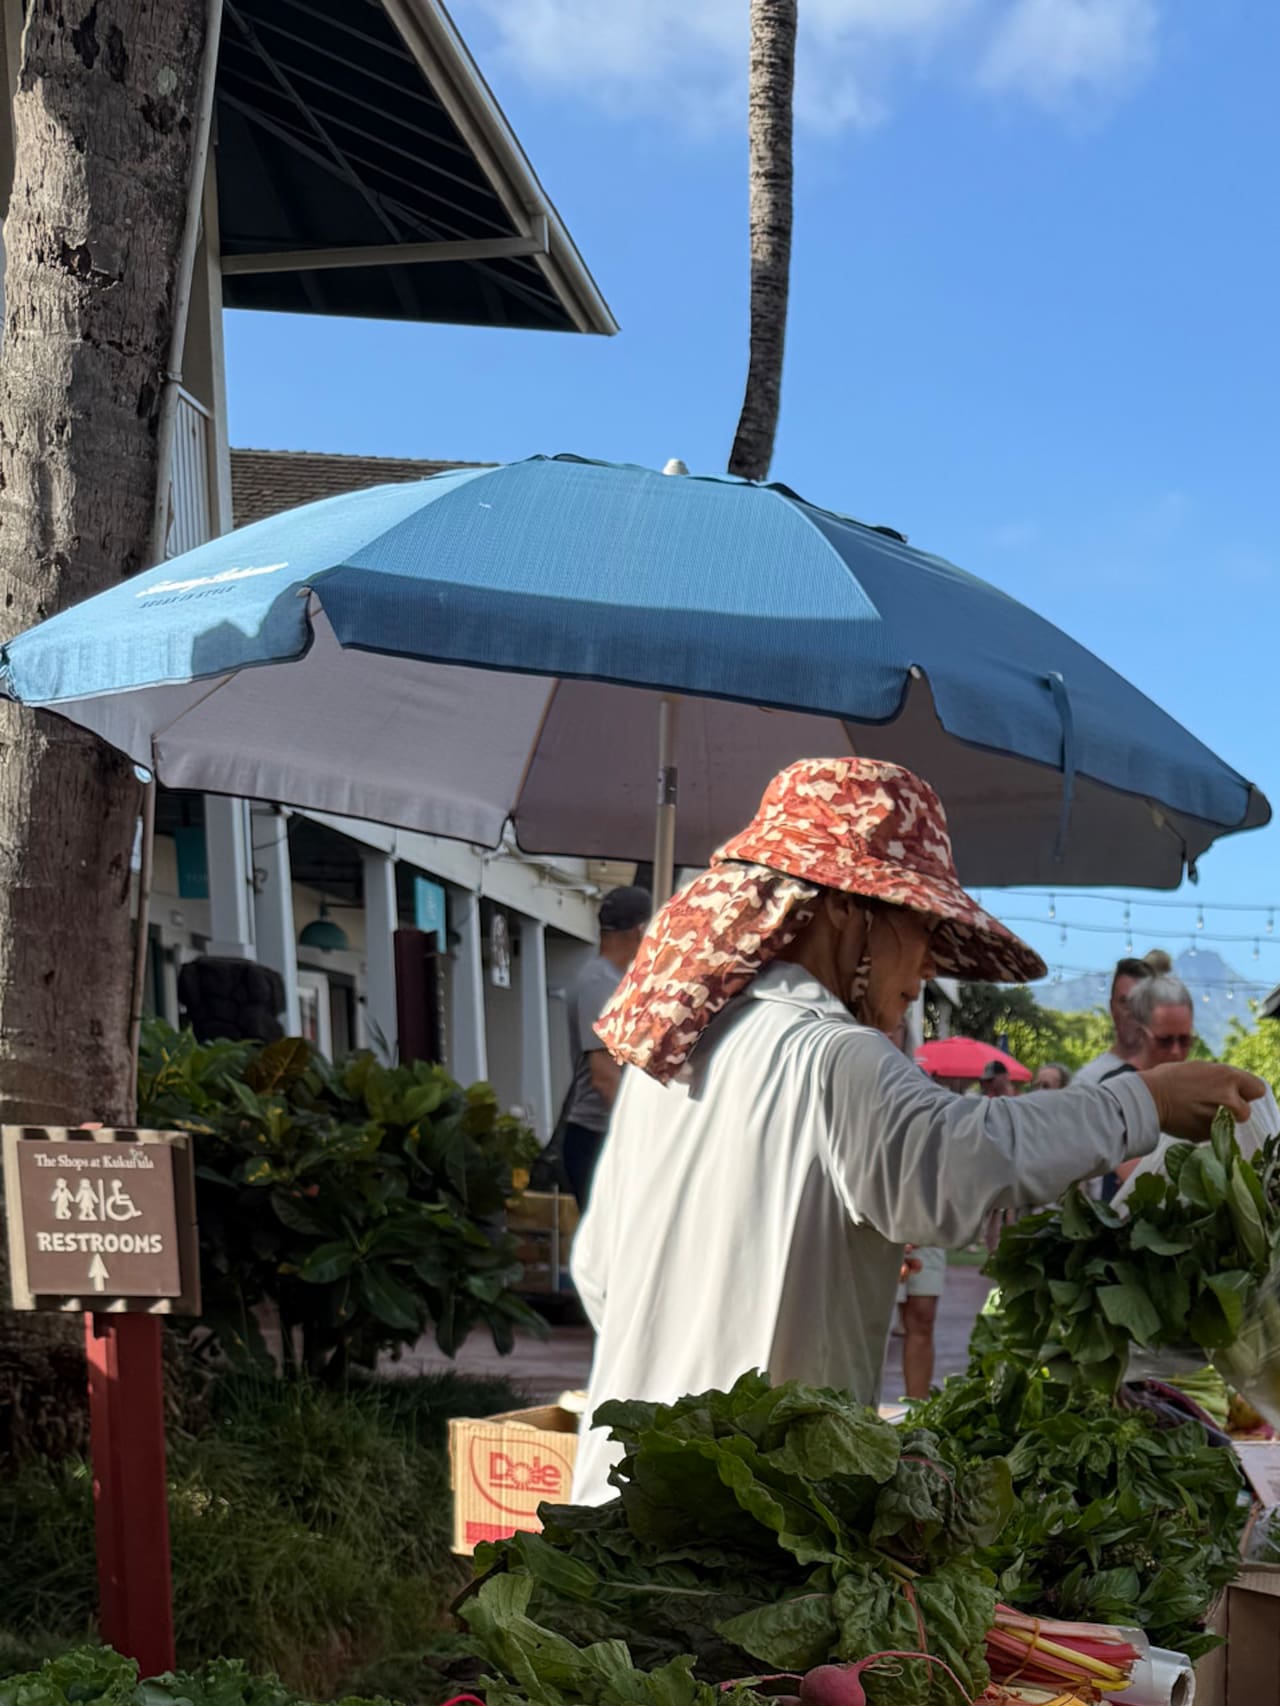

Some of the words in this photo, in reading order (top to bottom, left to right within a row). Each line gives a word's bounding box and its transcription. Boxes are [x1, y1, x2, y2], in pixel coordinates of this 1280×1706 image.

[34, 1153, 57, 1168] The
[57, 1154, 89, 1171] Shops
[90, 1158, 101, 1168] at
[36, 1232, 163, 1254] RESTROOMS
[489, 1452, 561, 1487] Dole
